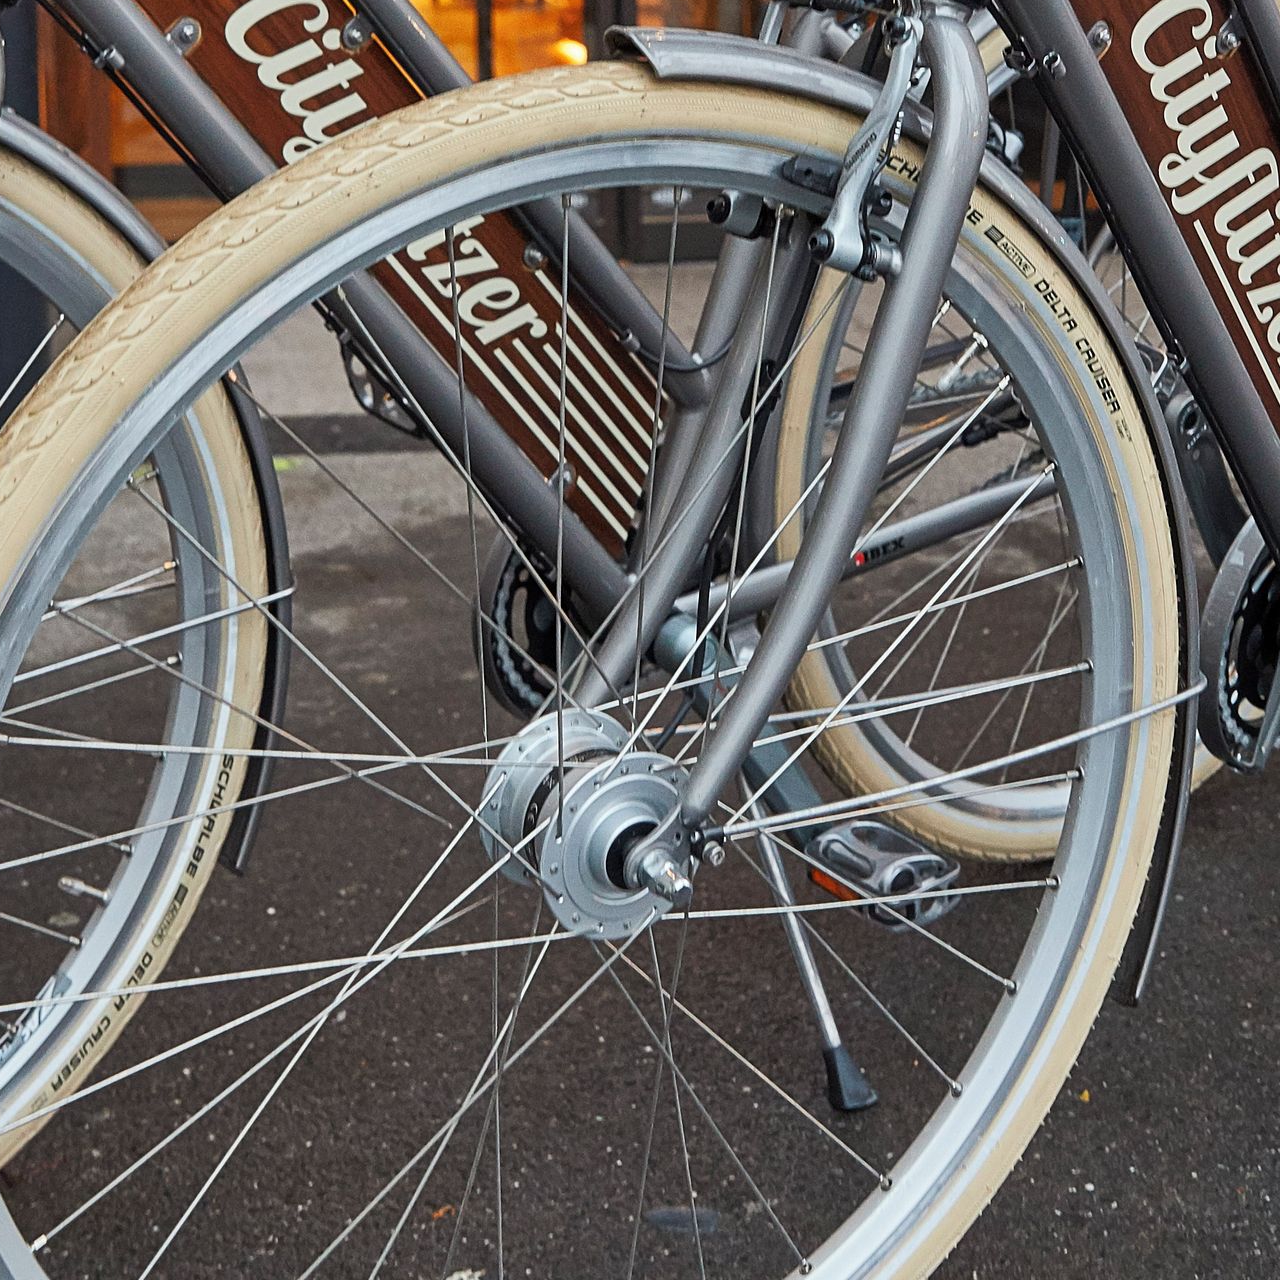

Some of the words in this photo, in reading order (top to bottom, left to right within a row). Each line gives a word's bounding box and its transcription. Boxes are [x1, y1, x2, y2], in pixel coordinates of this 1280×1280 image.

[999, 240, 1032, 273] ACTIVE
[1034, 279, 1078, 332] DELTA
[1075, 338, 1120, 414] CRUISER
[51, 1016, 112, 1093] CRUISER
